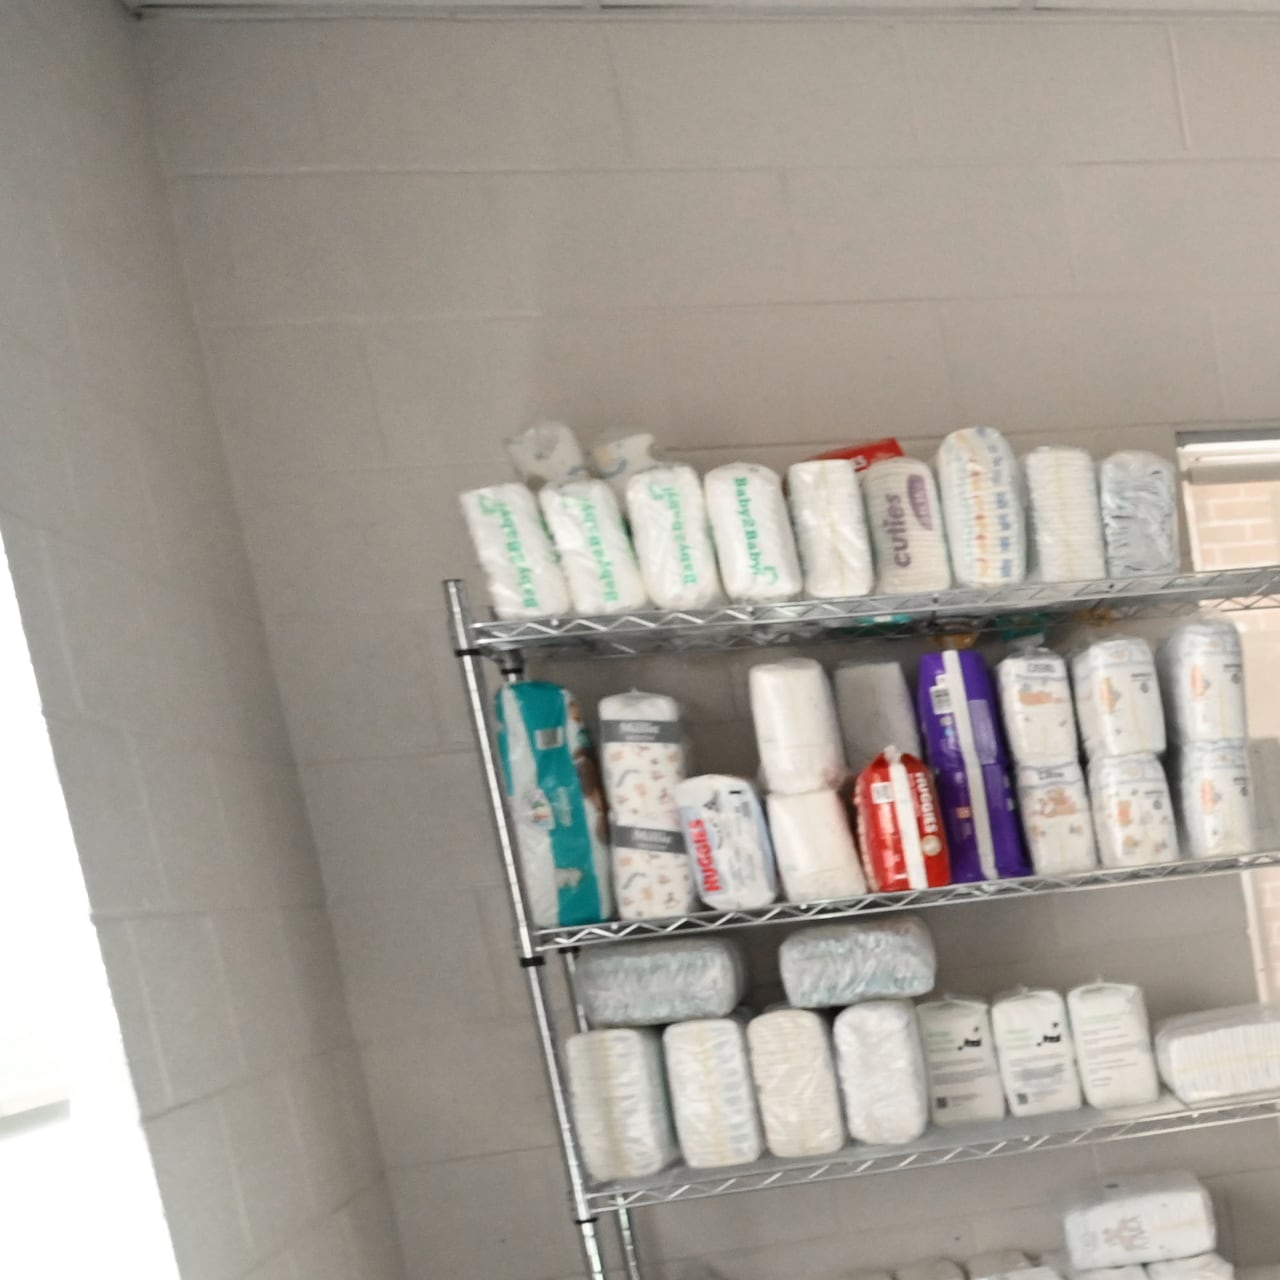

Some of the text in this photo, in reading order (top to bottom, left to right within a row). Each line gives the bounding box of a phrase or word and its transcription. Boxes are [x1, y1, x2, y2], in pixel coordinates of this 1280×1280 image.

[734, 476, 763, 576] Baby2Baby
[883, 494, 911, 568] cuties
[914, 771, 938, 834] HUGGIES
[688, 818, 722, 892] HUGGIES
